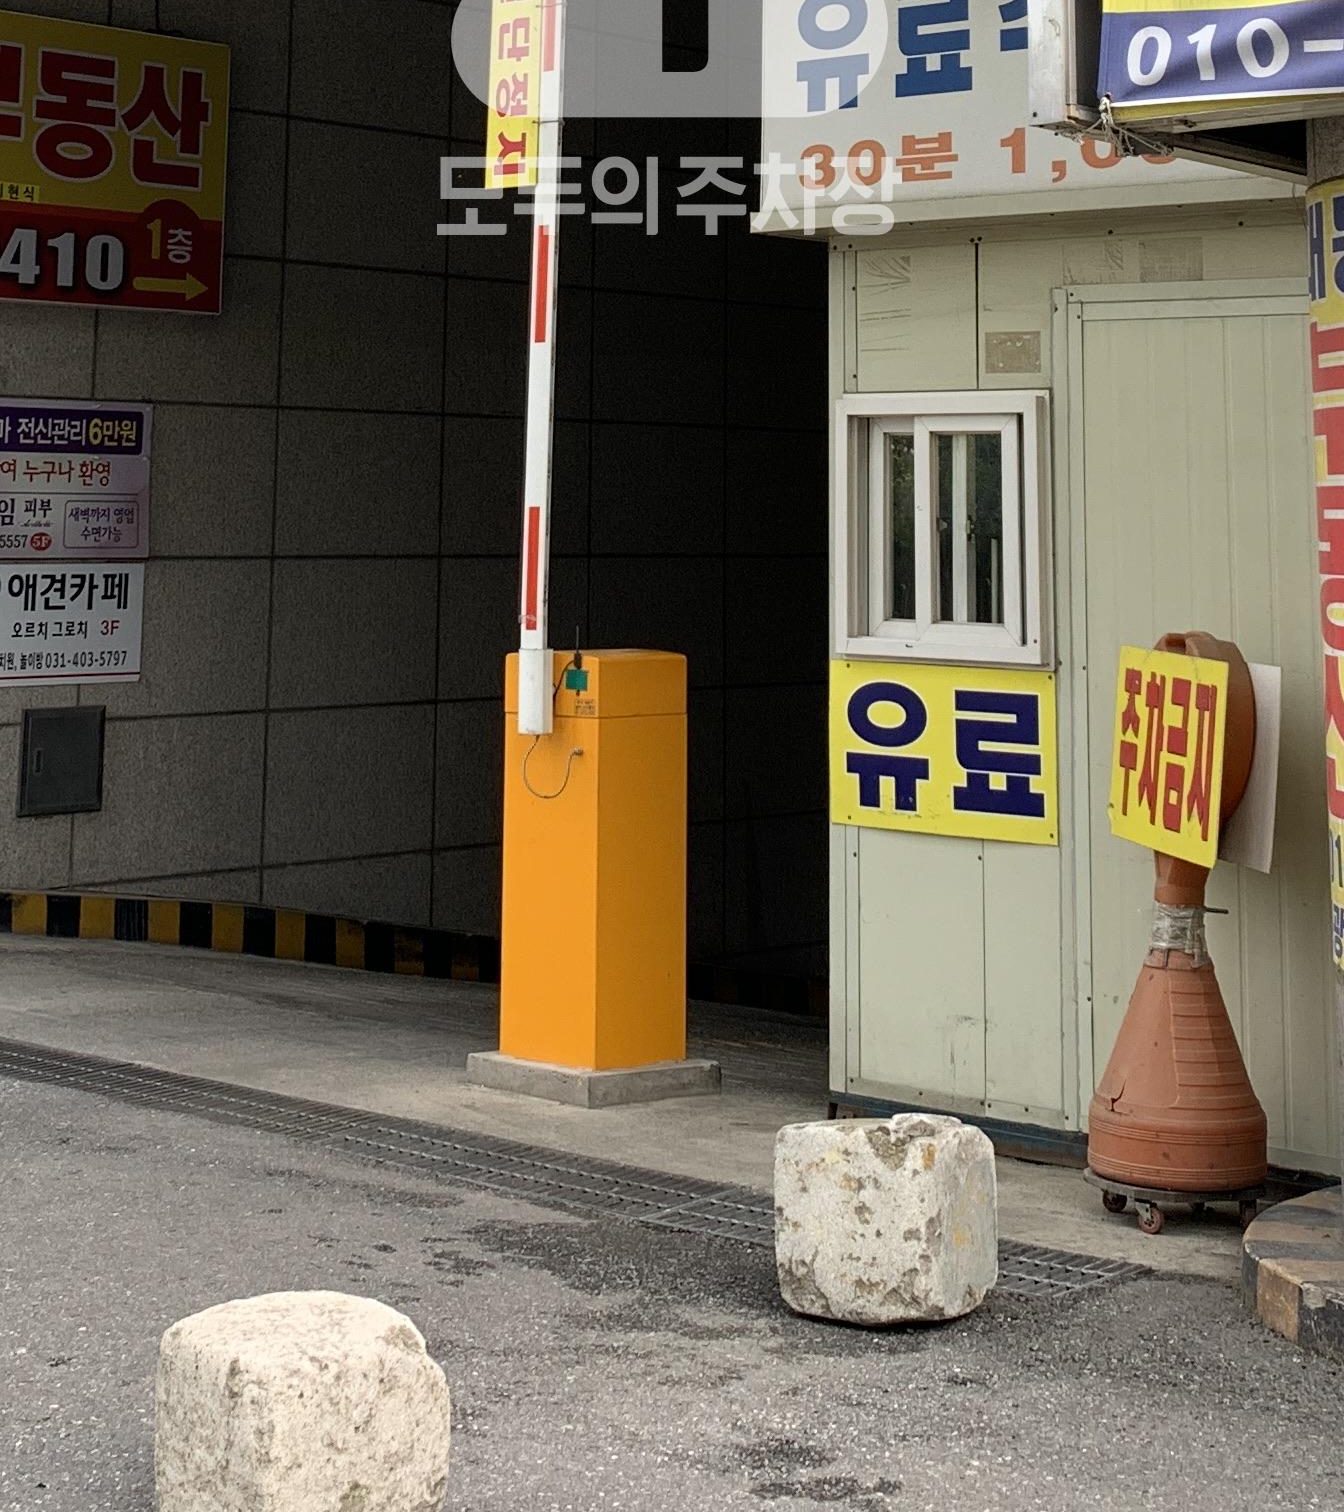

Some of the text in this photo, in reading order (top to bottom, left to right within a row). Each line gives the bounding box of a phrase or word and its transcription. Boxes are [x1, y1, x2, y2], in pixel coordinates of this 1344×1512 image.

[798, 129, 960, 192] 30분
[145, 217, 195, 265] 1층
[22, 459, 76, 484] 누구나
[78, 460, 112, 488] 환영
[23, 498, 53, 519] 피부
[67, 507, 112, 525] 새벽까지
[113, 508, 135, 525] 영업
[31, 534, 51, 550] 5F
[7, 572, 130, 612] 애견카페
[10, 619, 121, 640] 오르치 그로치 3F
[19, 650, 44, 671] 놀이방
[44, 650, 128, 670] 031-403-5797
[846, 681, 1047, 819] 유료
[1118, 667, 1220, 843] 주차금지
